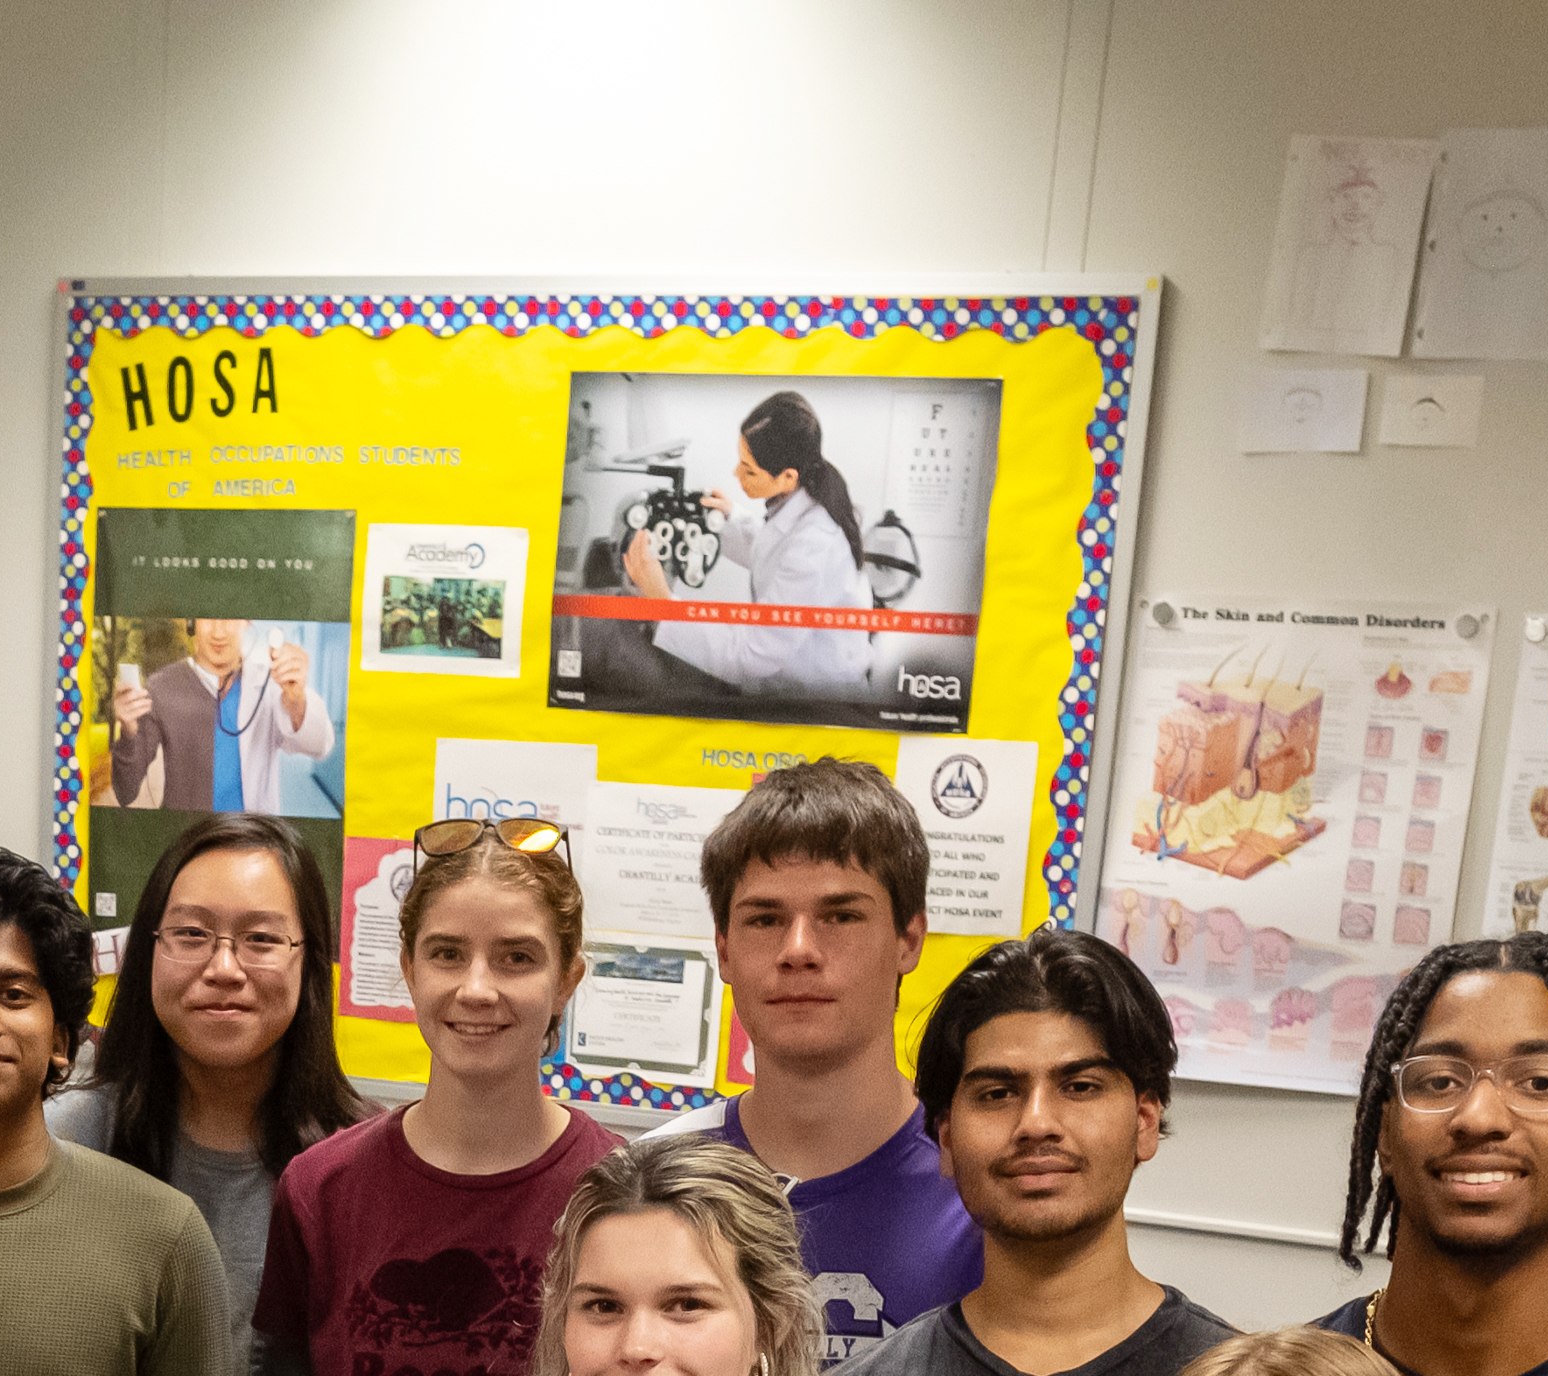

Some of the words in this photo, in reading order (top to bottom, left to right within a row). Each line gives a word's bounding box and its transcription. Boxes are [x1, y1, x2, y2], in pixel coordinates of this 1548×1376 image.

[121, 347, 278, 431] HOSA
[117, 449, 193, 469] HEALTH
[209, 444, 345, 464] OCCUPATIONS
[358, 445, 462, 466] STUDENTS
[167, 480, 192, 499] OF
[212, 478, 297, 497] AMERICA
[687, 606, 721, 619] CAN
[728, 608, 762, 621] YOU
[772, 609, 803, 623] SEE
[813, 611, 901, 629] YOURSELF
[1180, 606, 1209, 620] The
[1215, 608, 1250, 622] Skin
[1256, 611, 1284, 623] and
[1290, 611, 1360, 626] Common
[1366, 614, 1446, 630] Disorders
[897, 665, 962, 700] hosa
[925, 832, 1005, 844] NGRATULATIONS
